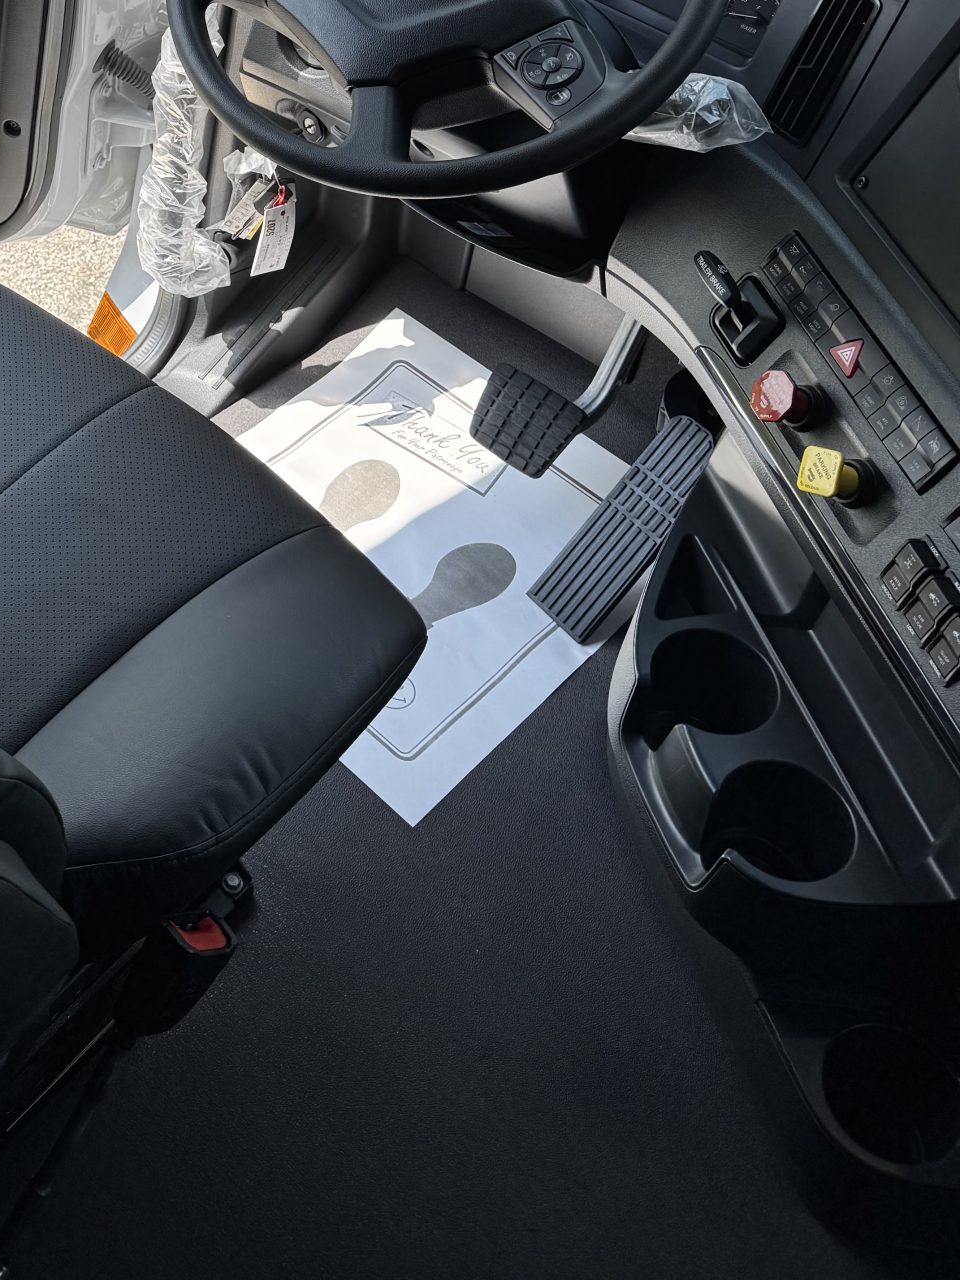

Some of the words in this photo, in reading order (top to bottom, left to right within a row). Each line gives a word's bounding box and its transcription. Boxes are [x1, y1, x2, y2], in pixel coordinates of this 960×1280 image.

[740, 24, 757, 34] WATER
[266, 219, 276, 237] 5207
[697, 255, 712, 278] TRAILER
[709, 275, 726, 296] BRAKE
[392, 429, 407, 440] For
[409, 437, 425, 450] Your
[425, 448, 463, 473] Patronage
[456, 444, 489, 473] You
[812, 462, 823, 480] BRAKE
[815, 452, 832, 481] PARKING
[930, 545, 939, 558] LOCK
[906, 624, 915, 636] LOCK
